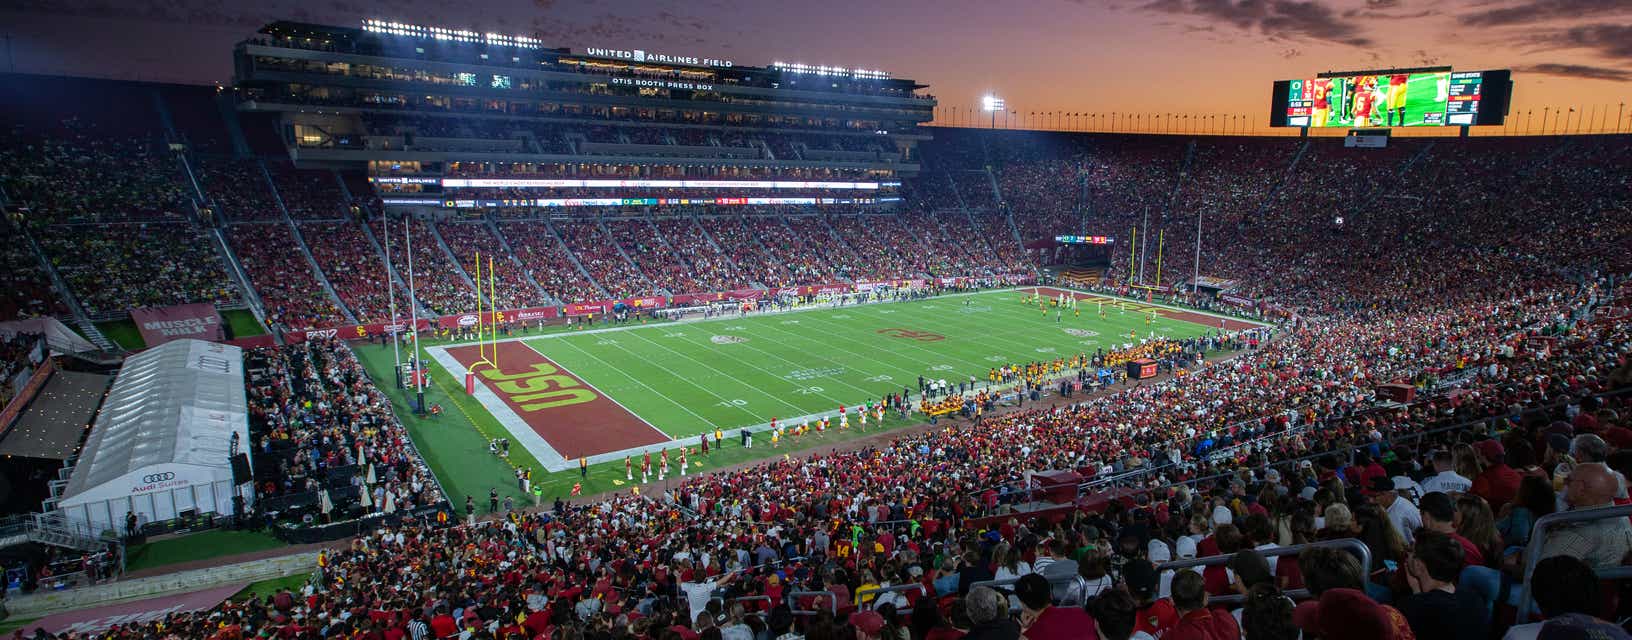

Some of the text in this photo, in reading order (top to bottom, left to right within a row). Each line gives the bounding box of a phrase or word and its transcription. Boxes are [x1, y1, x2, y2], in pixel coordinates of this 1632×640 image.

[587, 47, 733, 67] UNITED AIRLINES FIELD
[636, 79, 664, 87] BOOTH
[143, 315, 217, 331] MUSCLE
[160, 325, 208, 336] MILK
[480, 362, 598, 412] USC
[131, 478, 189, 493] Audi Suites
[837, 544, 850, 557] 14
